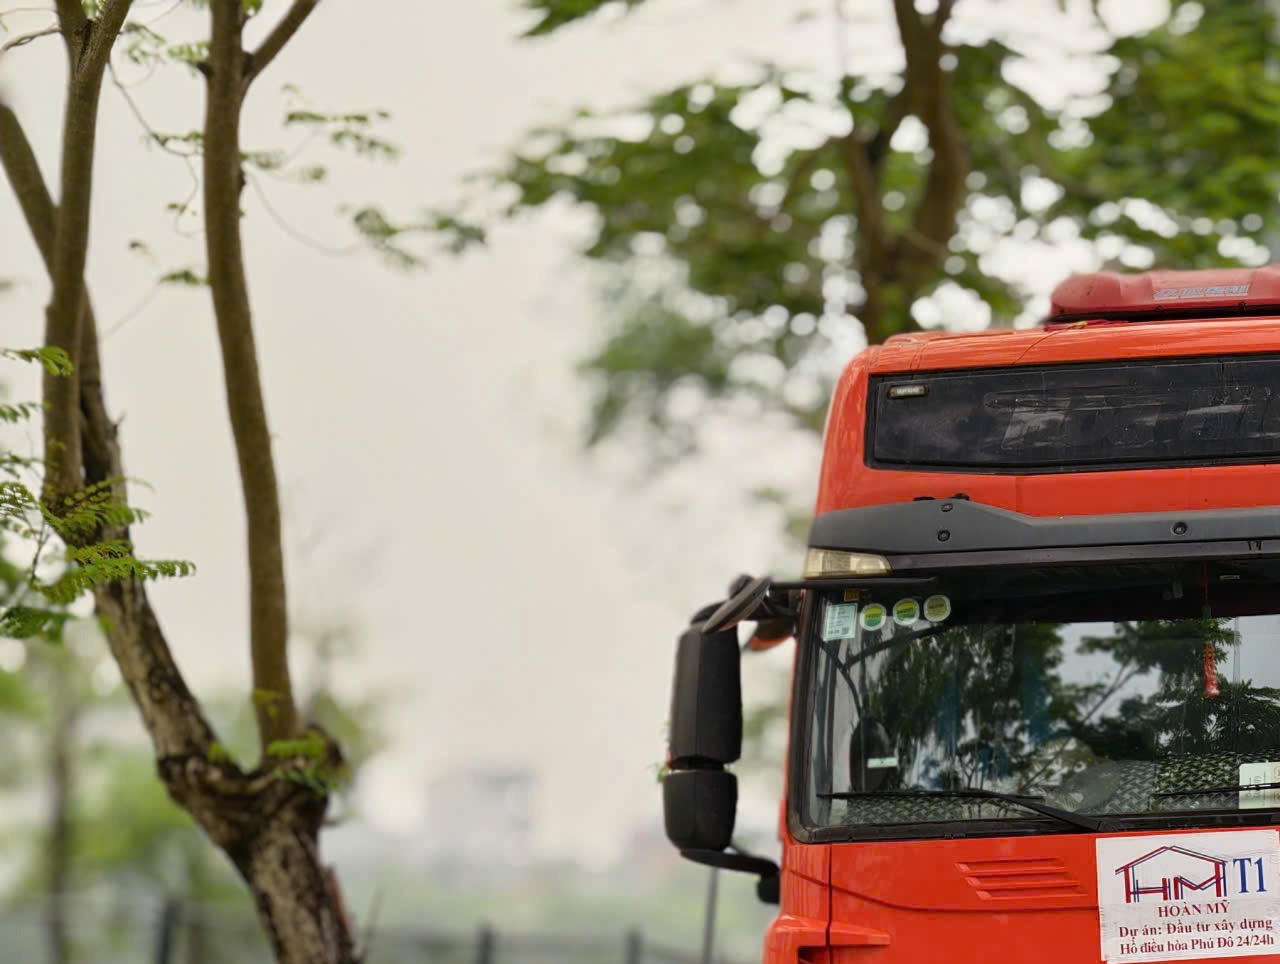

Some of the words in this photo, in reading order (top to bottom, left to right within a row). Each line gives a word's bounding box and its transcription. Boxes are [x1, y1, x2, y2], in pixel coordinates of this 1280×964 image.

[1232, 857, 1267, 894] T1
[1158, 902, 1202, 918] HOÀN
[1206, 899, 1231, 916] MỸ
[1119, 925, 1139, 940] Dự
[1142, 925, 1162, 936] án:
[1166, 919, 1192, 935] Đầu
[1213, 920, 1236, 934] xây
[1239, 917, 1273, 932] dựng
[1140, 938, 1164, 953] điều
[1167, 939, 1188, 951] hòa
[1191, 937, 1214, 950] Phú
[1217, 936, 1234, 948] Đô
[1237, 933, 1275, 948] 24/24h
